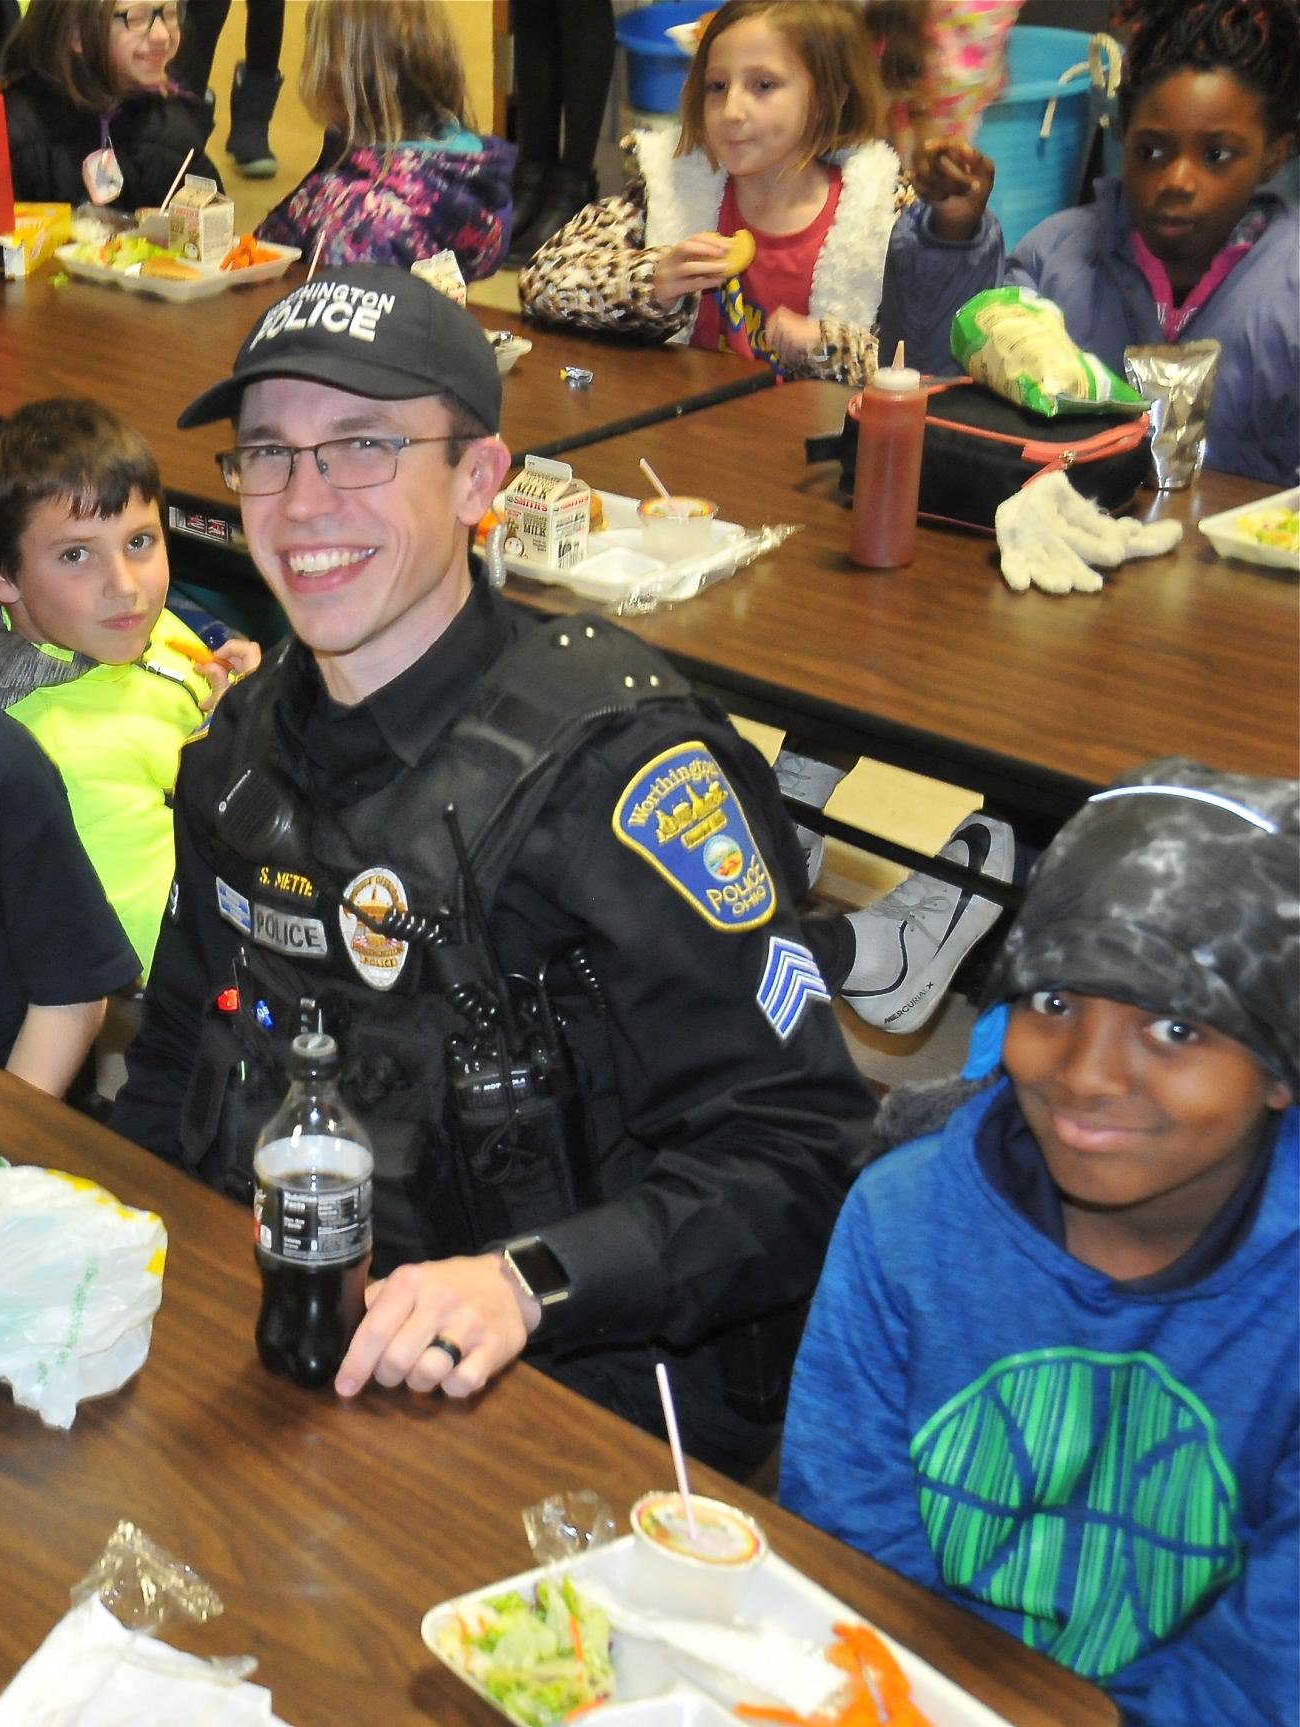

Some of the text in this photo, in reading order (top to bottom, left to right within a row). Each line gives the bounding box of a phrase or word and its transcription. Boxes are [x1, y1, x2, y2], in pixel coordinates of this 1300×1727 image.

[250, 300, 382, 350] POLICE
[523, 524, 547, 537] MILK
[706, 854, 766, 914] POLICE
[732, 886, 766, 916] OHIO
[255, 911, 321, 948] POLICE
[483, 1077, 526, 1091] MOTOLA
